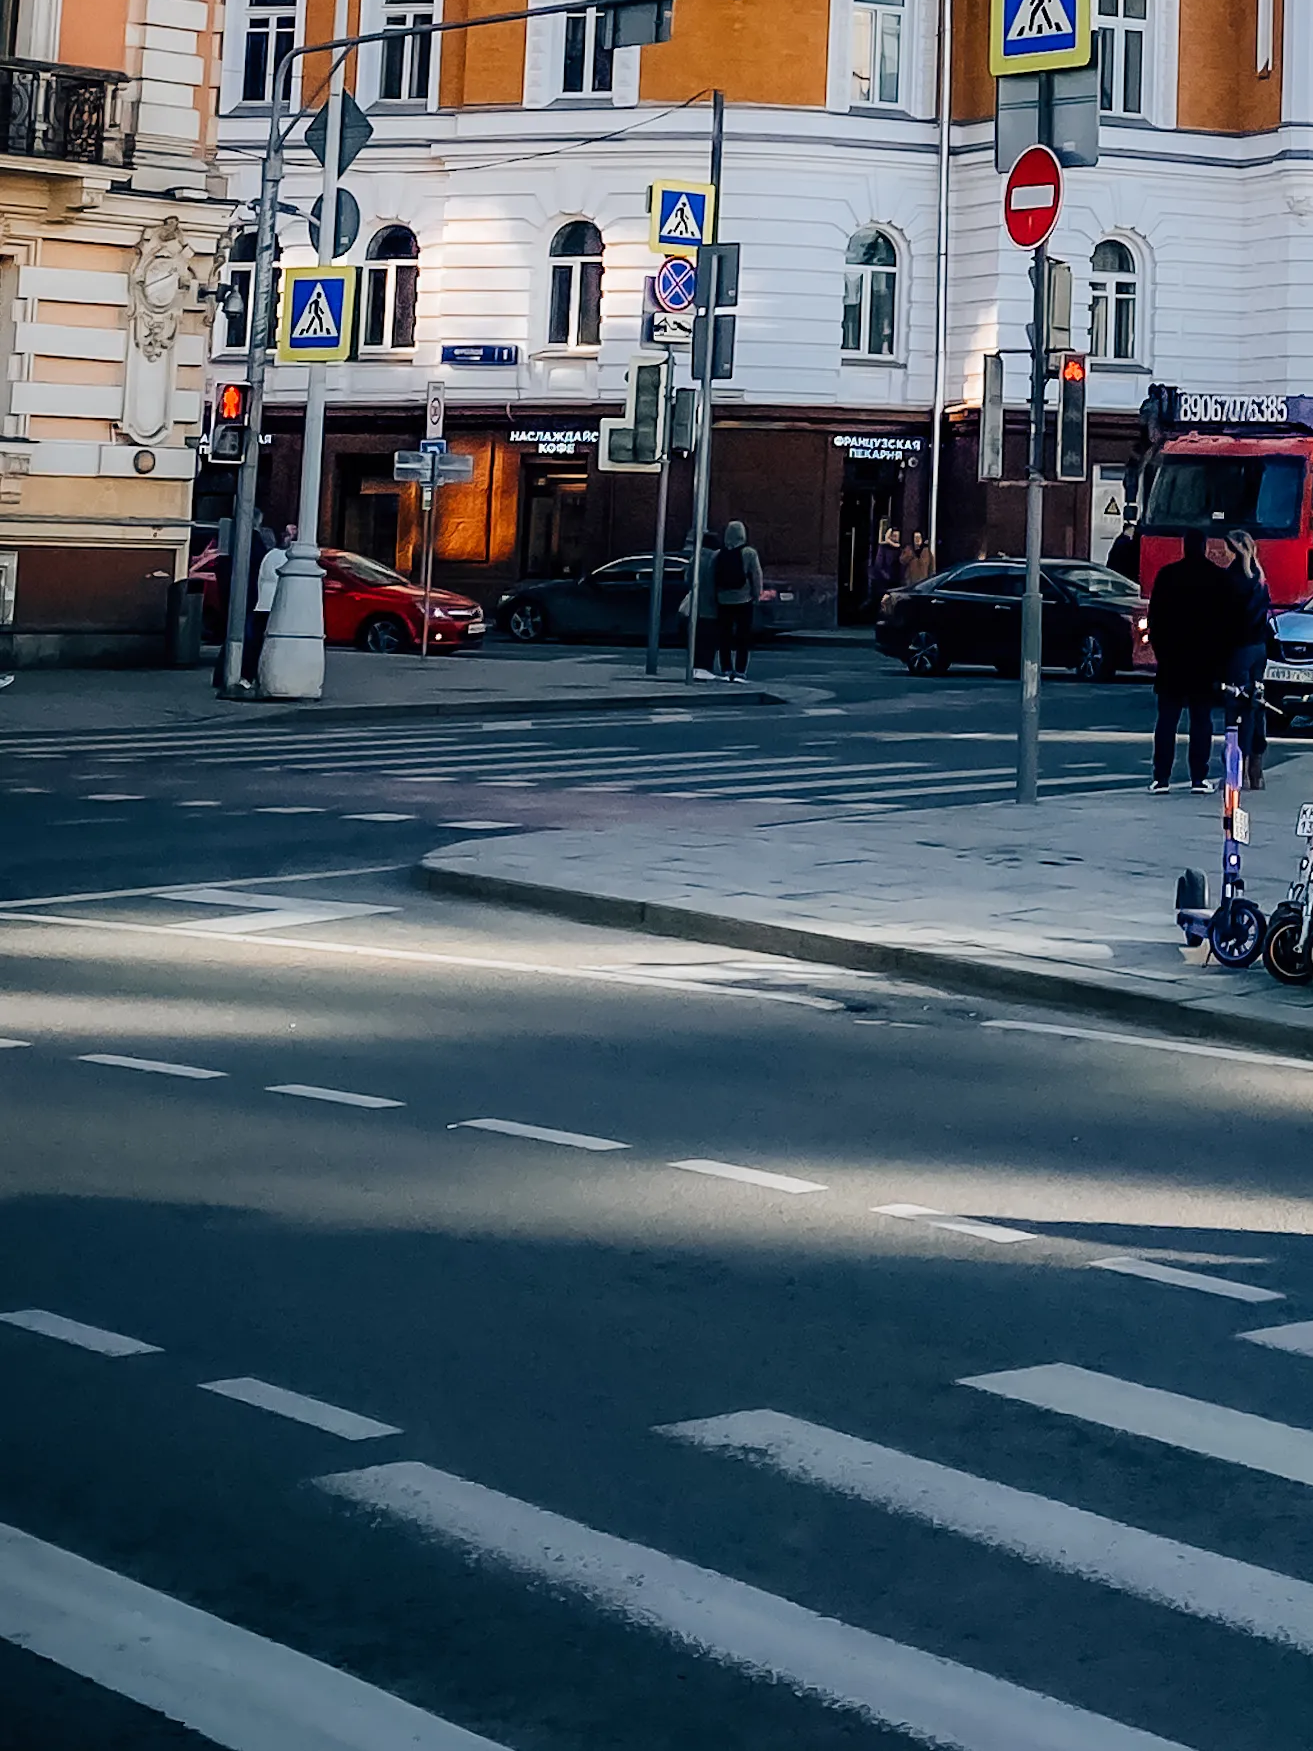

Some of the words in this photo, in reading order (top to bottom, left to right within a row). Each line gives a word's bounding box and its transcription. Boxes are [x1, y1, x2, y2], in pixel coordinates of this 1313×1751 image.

[1180, 395, 1287, 422] 89067076385
[510, 431, 599, 442] НАСЛАЖДАЙС
[538, 443, 575, 454] КОФЕ
[834, 436, 921, 451] ФРАНЦУЗСКАЯ
[849, 448, 903, 460] ПЕКАРНЯ
